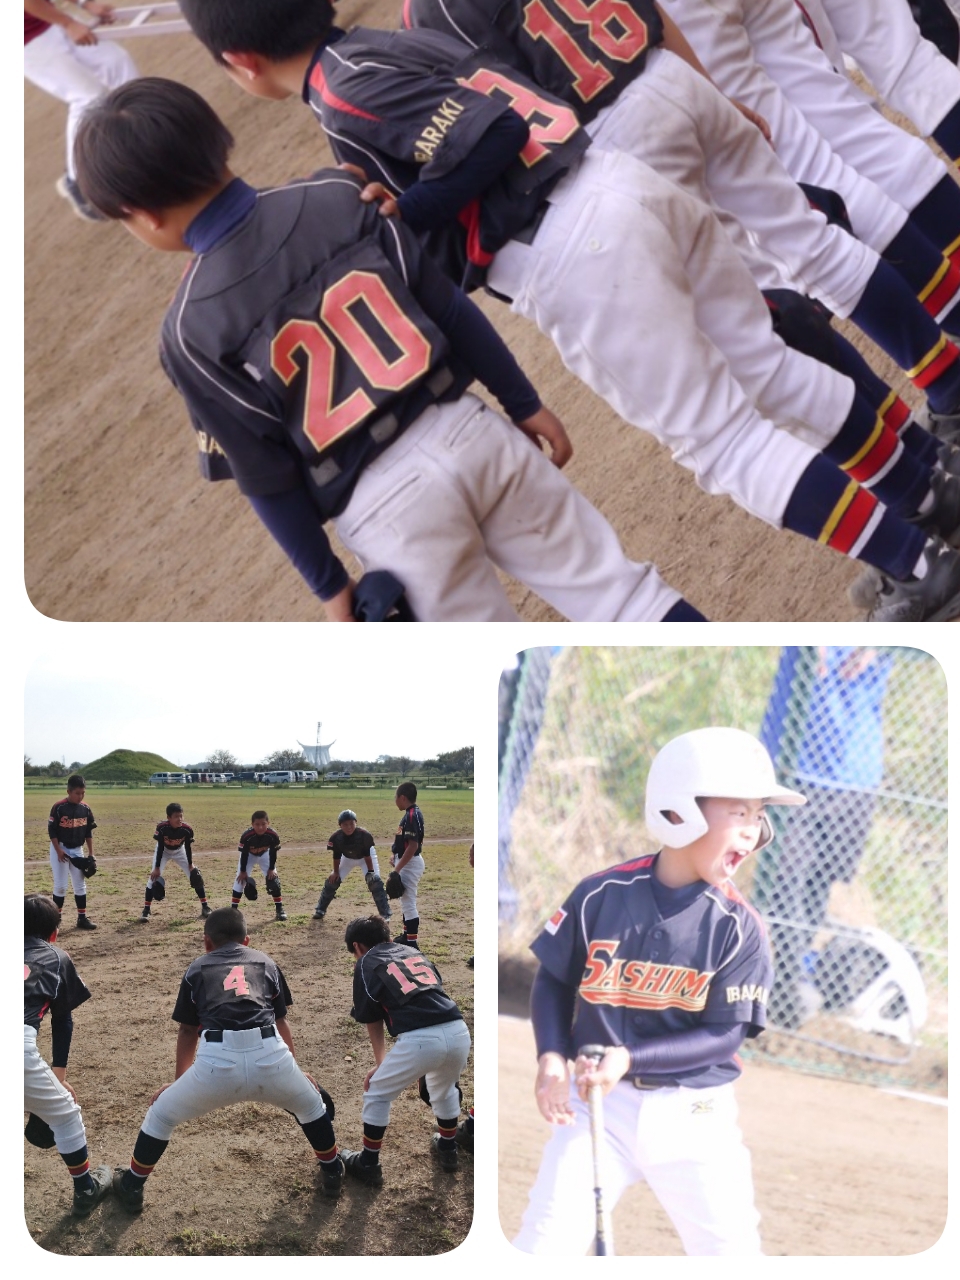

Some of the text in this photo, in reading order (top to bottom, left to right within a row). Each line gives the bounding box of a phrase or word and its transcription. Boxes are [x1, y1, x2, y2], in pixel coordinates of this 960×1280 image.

[270, 269, 432, 452] 20
[223, 965, 250, 997] 4
[386, 956, 438, 996] 15
